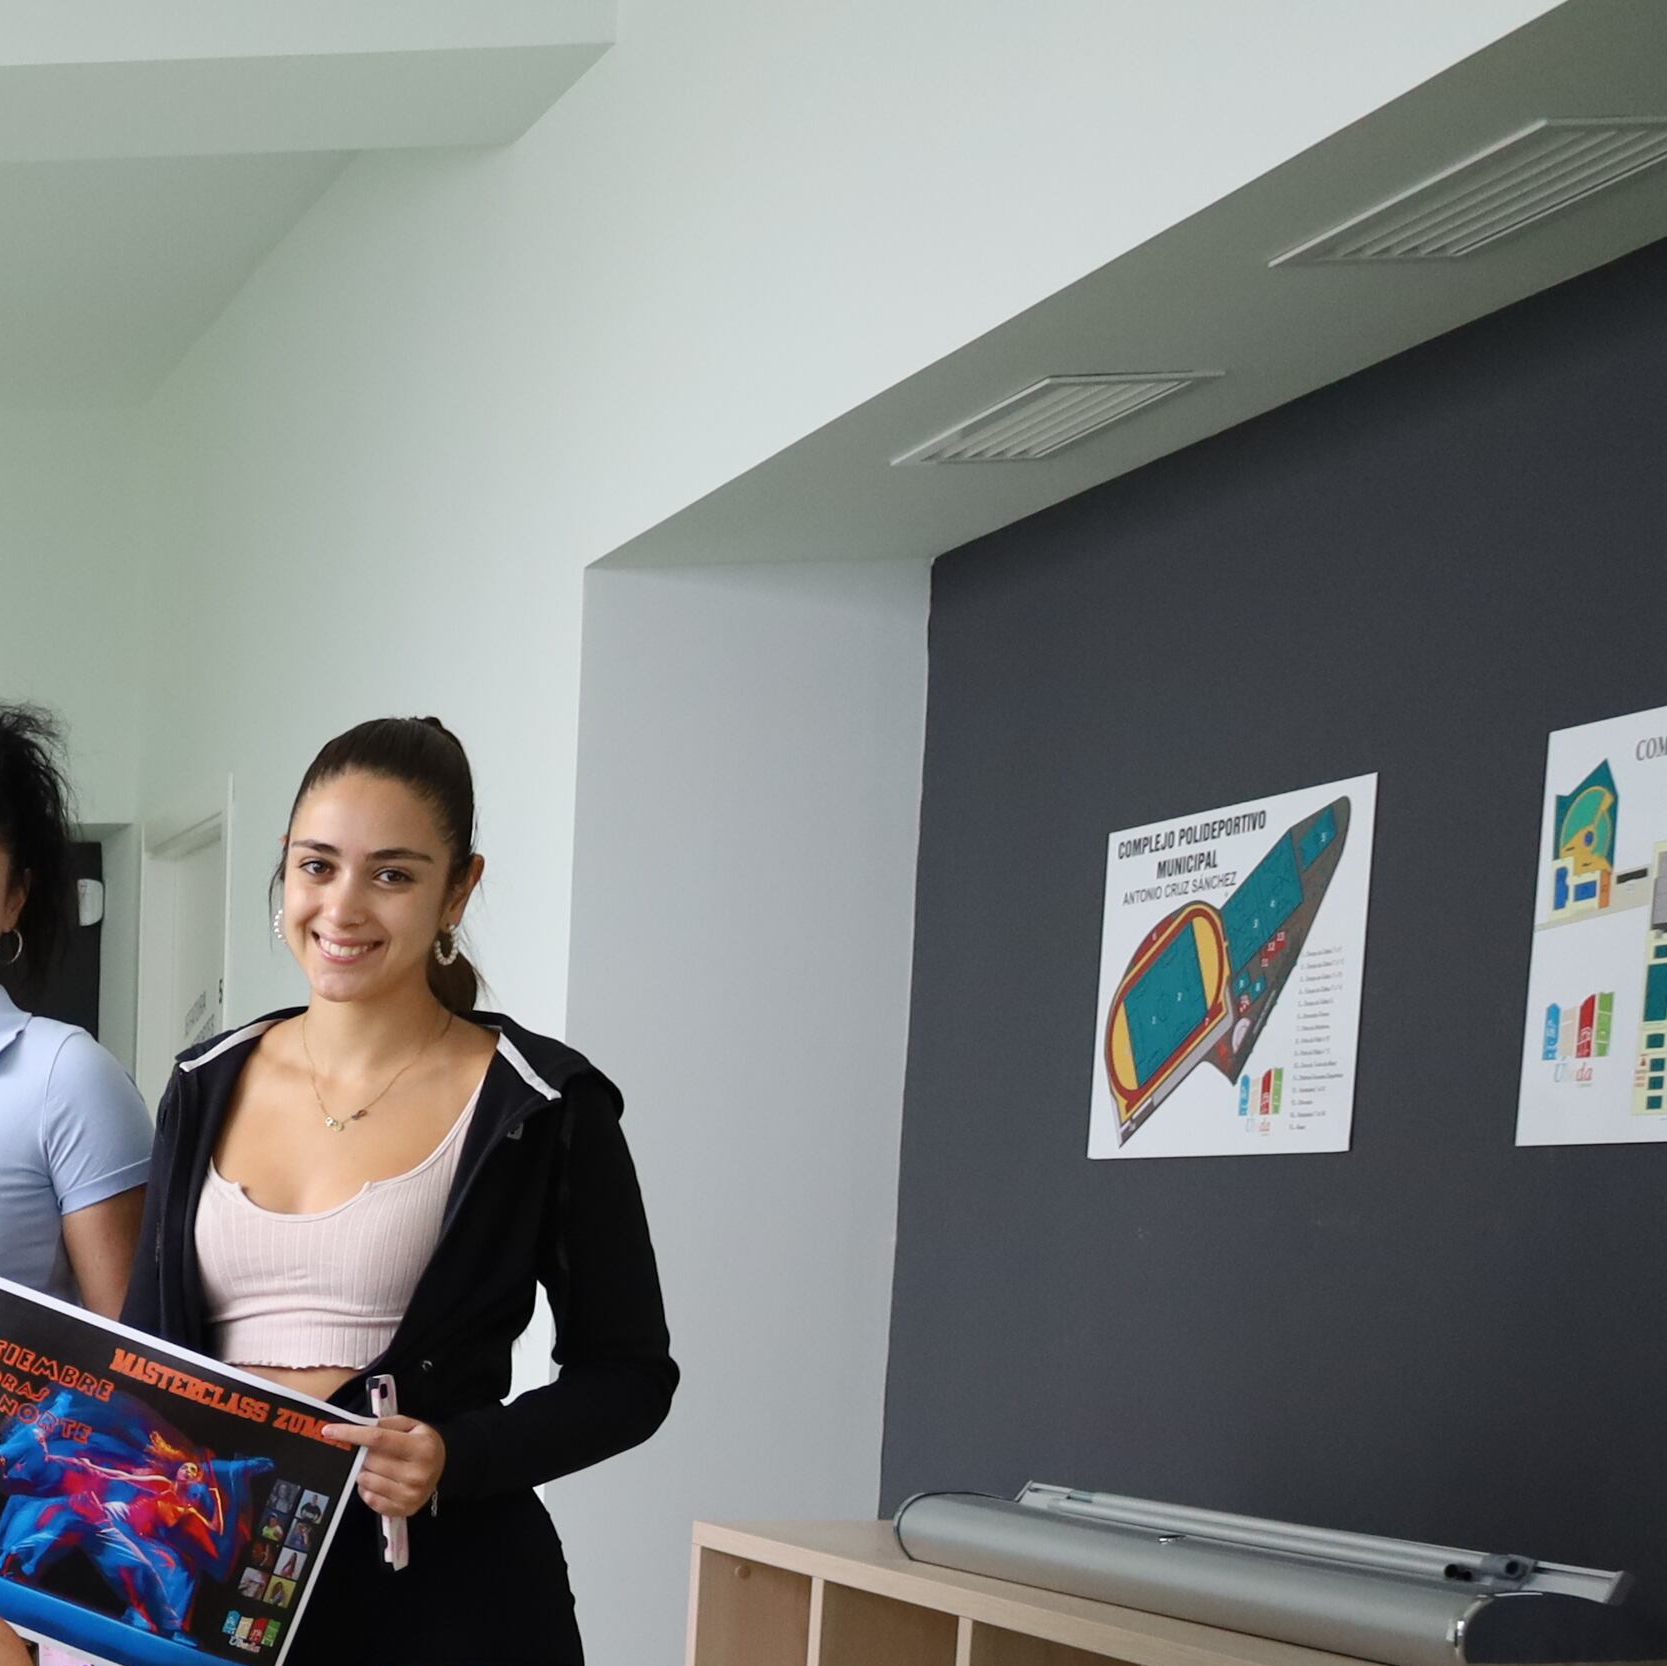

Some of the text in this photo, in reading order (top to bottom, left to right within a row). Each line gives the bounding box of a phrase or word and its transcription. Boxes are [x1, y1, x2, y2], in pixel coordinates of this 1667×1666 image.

[1118, 810, 1267, 860] COMPLEJO POLIDEPORTIVO
[1156, 850, 1219, 880] MUNICIPAL
[1122, 871, 1238, 906] ANTONIO CRUZ SÁNCHEZ
[109, 1347, 271, 1423] MASTERCLASS
